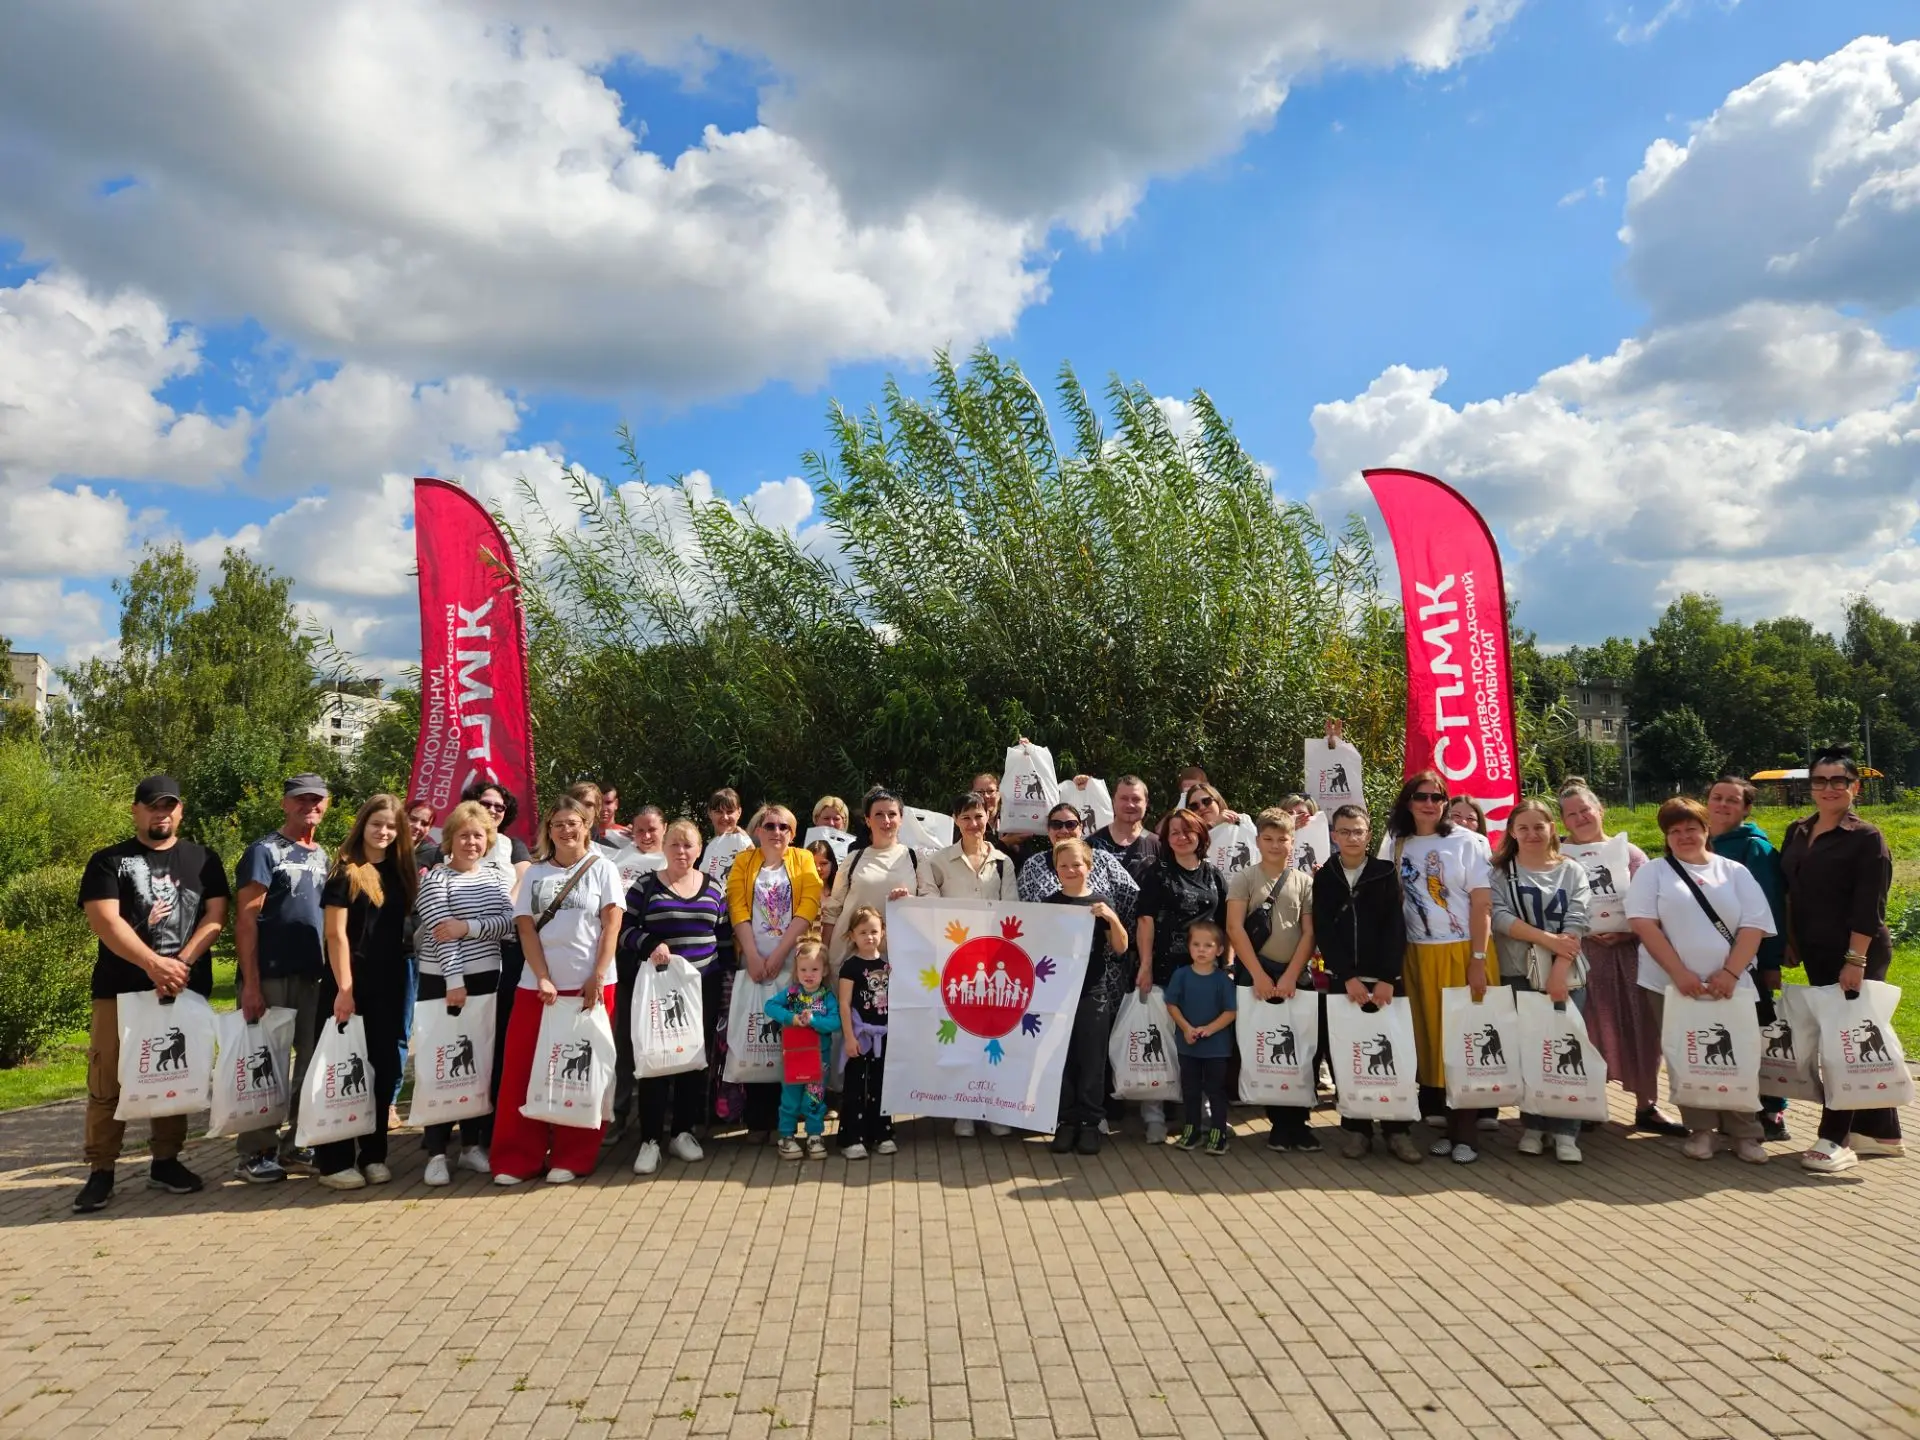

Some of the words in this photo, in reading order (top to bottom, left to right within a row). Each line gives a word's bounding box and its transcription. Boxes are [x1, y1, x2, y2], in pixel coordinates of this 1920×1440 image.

[1416, 574, 1477, 781] СПМК
[1461, 571, 1500, 780] СЕРГИЕВО-ПОСАДСКИЙ
[1480, 629, 1513, 780] МЯСОКОМБИНАТ
[747, 1012, 757, 1043] СПМК
[139, 1038, 152, 1074] СПМК
[435, 1046, 445, 1081] СПМК
[1129, 1031, 1138, 1063] СПМК
[1256, 1031, 1265, 1063] СПМК
[1353, 1041, 1361, 1075] СПМК
[1464, 1033, 1474, 1066] СПМК
[1542, 1040, 1552, 1073] СПМК
[1687, 1030, 1698, 1064] СПМК
[1840, 1030, 1855, 1064] СПМК
[236, 1057, 246, 1091] СПМК
[325, 1064, 336, 1099] СПМК
